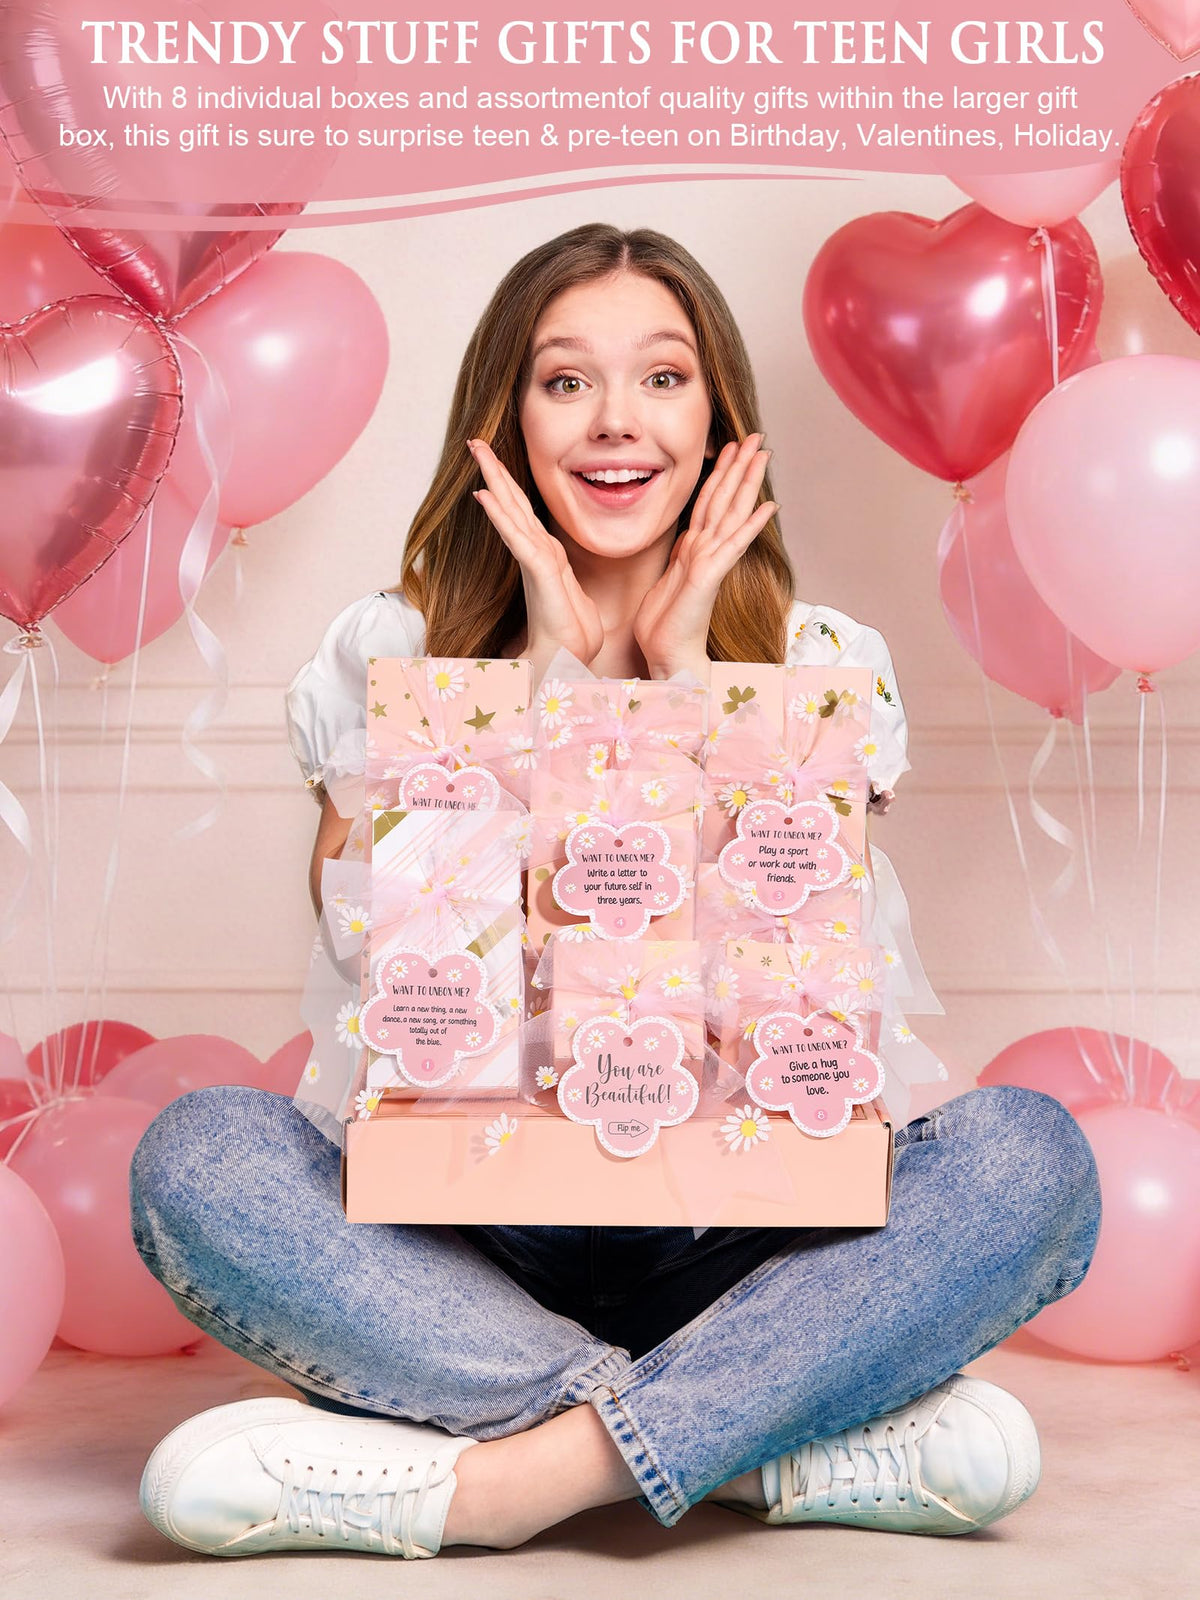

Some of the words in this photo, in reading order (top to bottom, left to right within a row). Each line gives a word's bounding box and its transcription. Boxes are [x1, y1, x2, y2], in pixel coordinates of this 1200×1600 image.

[412, 798, 431, 807] WANT
[434, 799, 443, 808] TO
[444, 800, 465, 810] UNBOX
[751, 830, 770, 838] WANT
[773, 831, 782, 839] TO
[784, 831, 805, 840] UNBOX
[807, 831, 822, 840] ME?
[759, 846, 777, 856] Play
[787, 848, 808, 856] sport
[582, 854, 601, 862] WANT
[605, 854, 614, 862] TO
[616, 854, 638, 862] UNBOX
[640, 854, 655, 862] ME?
[760, 860, 780, 868] work
[783, 861, 795, 869] out
[799, 861, 817, 870] with
[587, 869, 608, 877] Write
[618, 869, 637, 877] letter
[640, 869, 648, 877] to
[767, 873, 796, 883] friends.
[584, 883, 601, 893] your
[604, 882, 627, 891] future
[629, 882, 642, 891] self
[645, 882, 652, 891] in
[597, 896, 617, 905] three
[620, 897, 642, 906] years.
[393, 985, 414, 995] WANT
[417, 985, 427, 996] TO
[429, 986, 452, 997] UNBOX
[455, 987, 470, 997] ME?
[448, 1018, 477, 1027] something
[409, 1026, 428, 1036] totally
[441, 1027, 448, 1035] of
[772, 1044, 793, 1055] WANT
[796, 1044, 805, 1053] TO
[807, 1042, 831, 1052] UNBOX
[832, 1040, 848, 1050] ME?
[598, 1053, 635, 1085] You
[637, 1063, 665, 1078] are
[789, 1061, 810, 1071] Give
[820, 1059, 838, 1070] hug
[782, 1075, 790, 1084] to
[791, 1072, 831, 1083] someone
[832, 1070, 850, 1082] you
[585, 1081, 671, 1108] Beautiful!
[806, 1086, 829, 1096] love.
[617, 1124, 629, 1134] Flip
